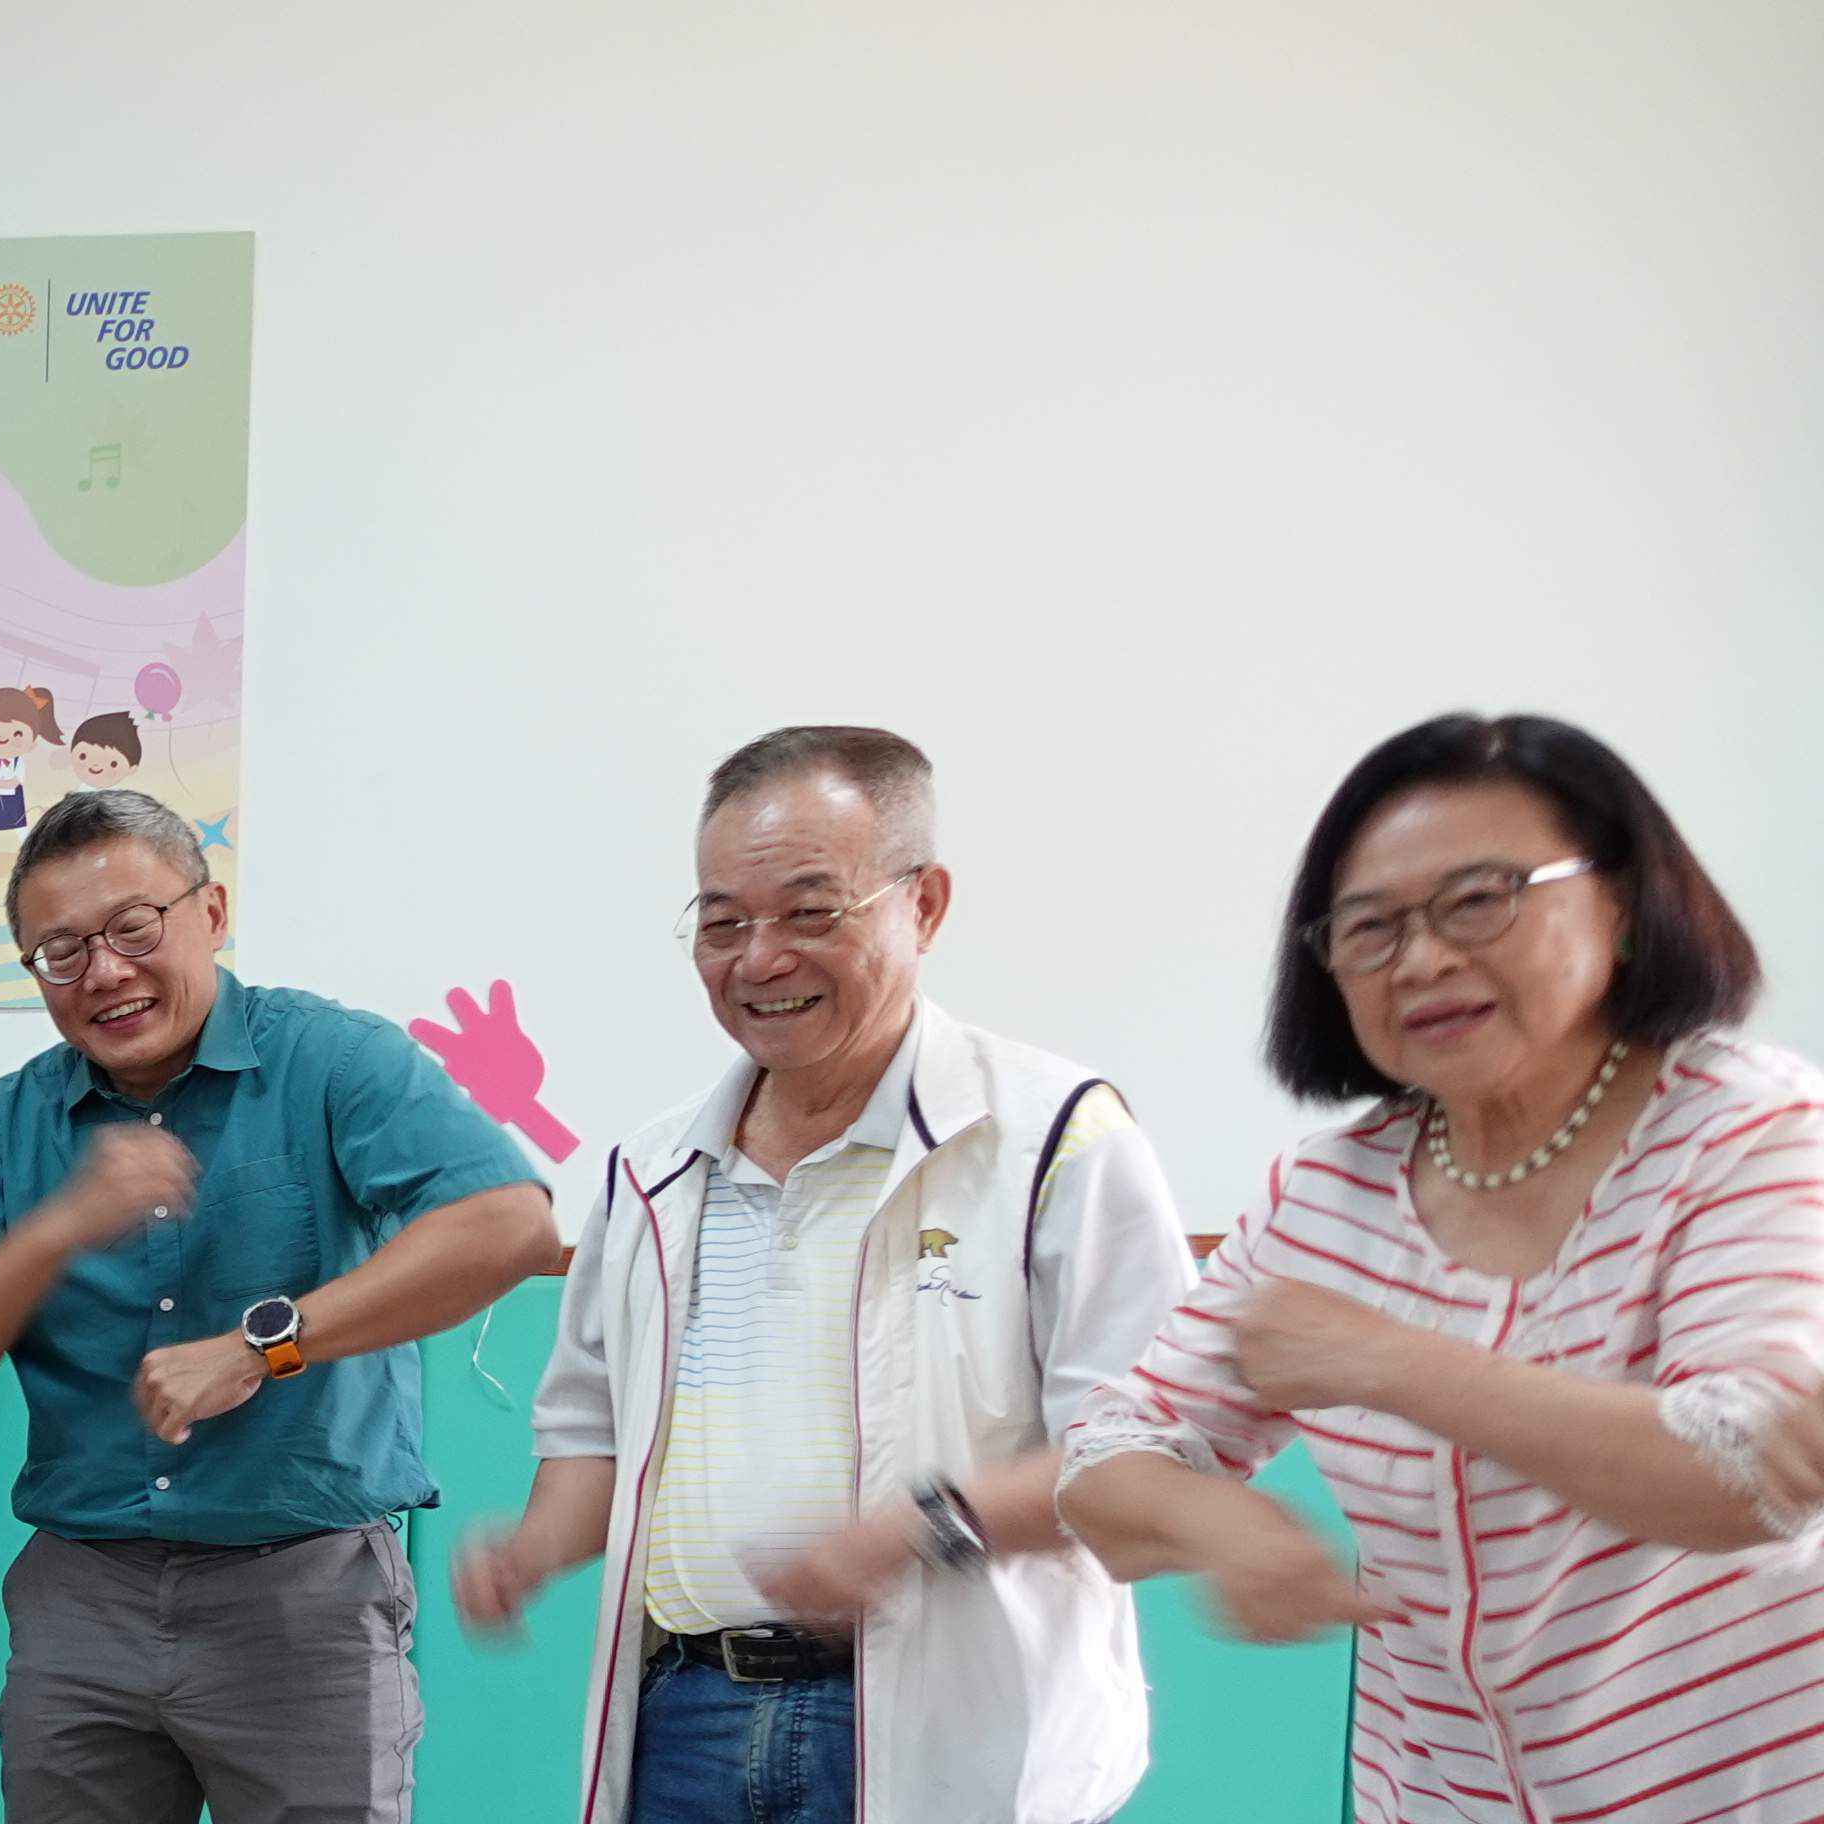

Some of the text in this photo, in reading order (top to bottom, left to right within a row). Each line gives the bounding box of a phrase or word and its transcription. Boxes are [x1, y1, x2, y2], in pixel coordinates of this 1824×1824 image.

[65, 291, 151, 316] UNITE
[96, 319, 155, 343] FOR
[105, 346, 190, 371] GOOD
